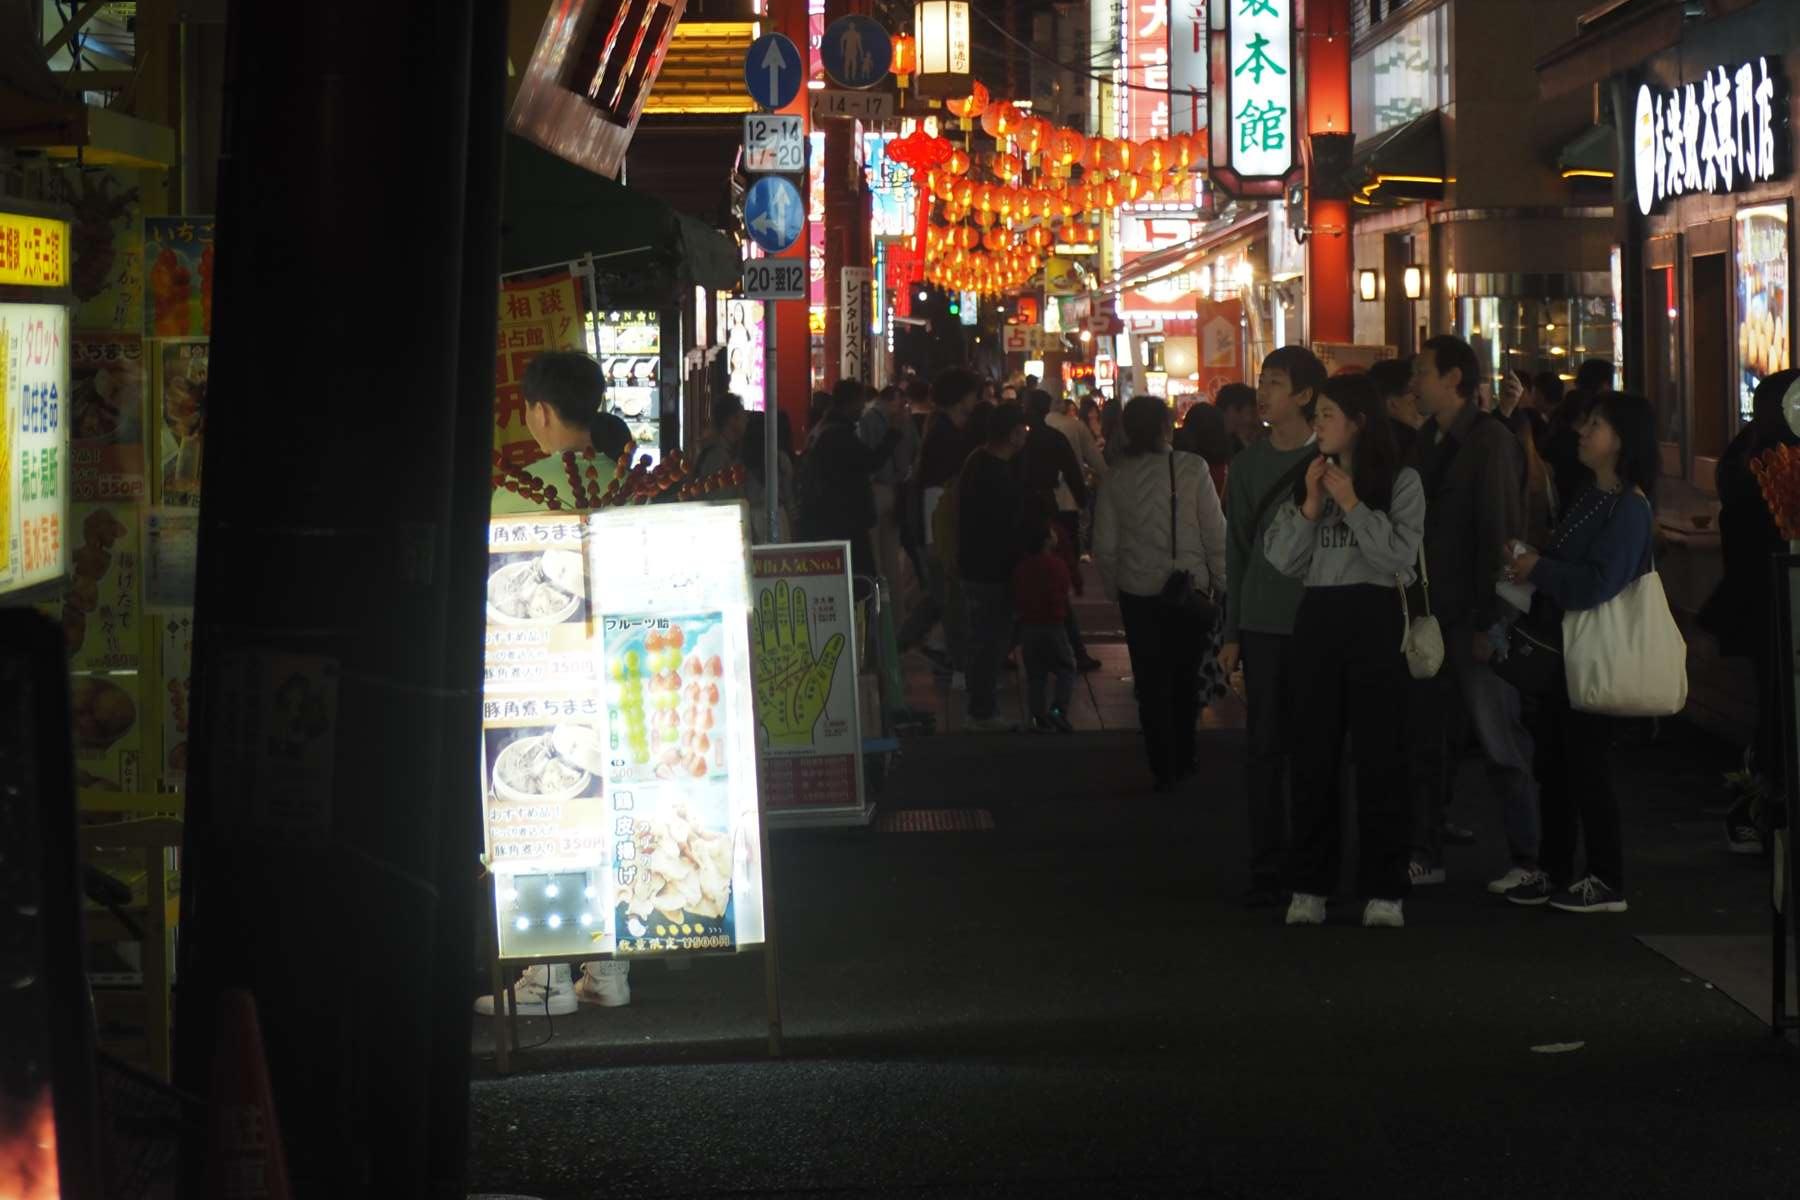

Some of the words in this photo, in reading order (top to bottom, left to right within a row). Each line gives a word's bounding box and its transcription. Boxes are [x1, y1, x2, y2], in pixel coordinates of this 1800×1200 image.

[749, 120, 798, 141] 12-14
[749, 146, 801, 165] 17-20
[505, 287, 565, 321] 相談
[22, 383, 58, 433] 四柱推命
